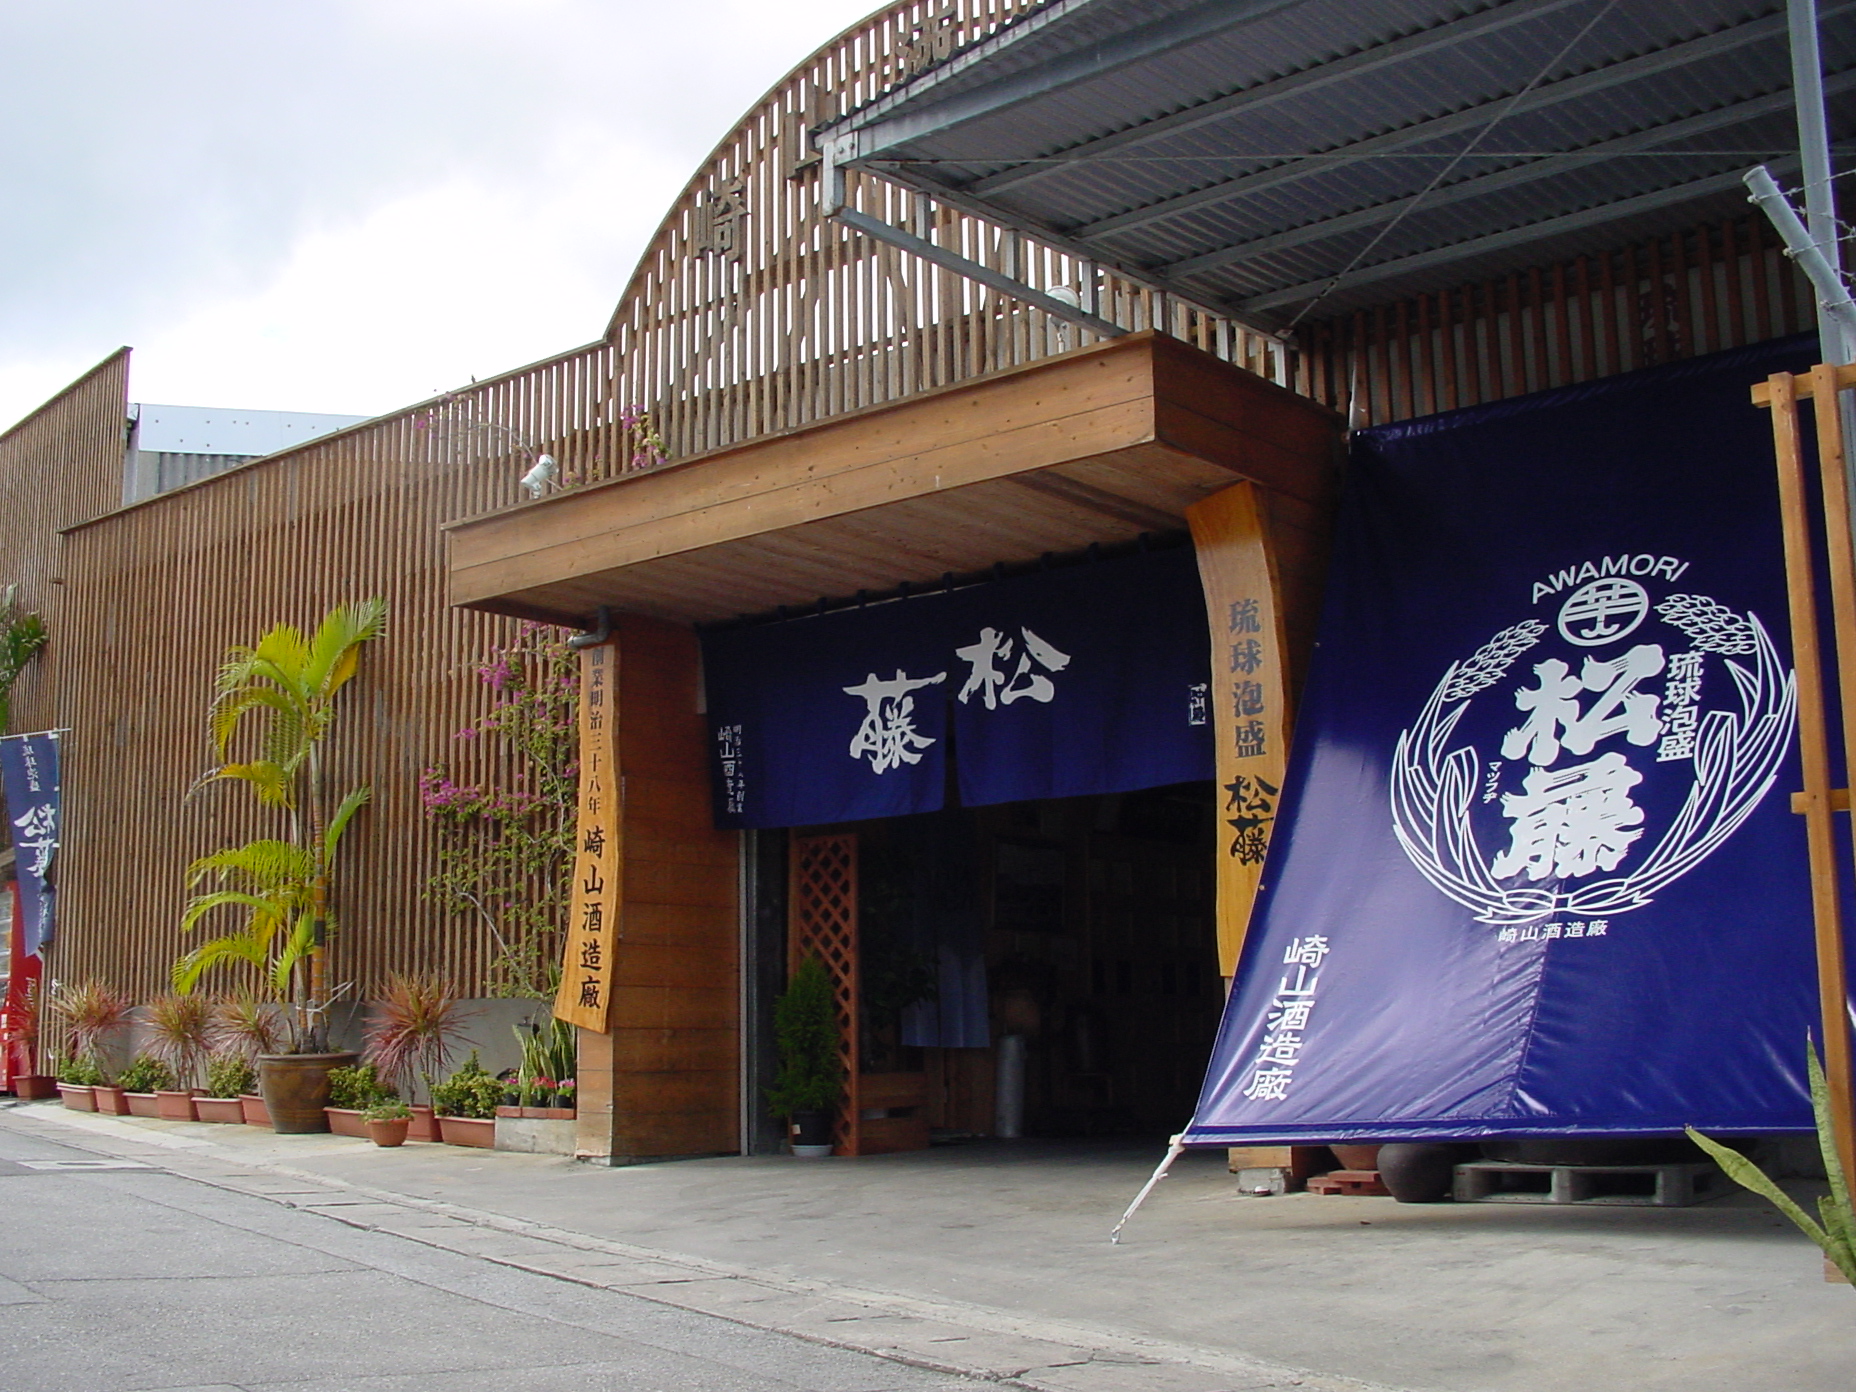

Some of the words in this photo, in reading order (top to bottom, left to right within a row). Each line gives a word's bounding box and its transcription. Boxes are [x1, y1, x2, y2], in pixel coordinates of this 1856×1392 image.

[1532, 553, 1690, 604] AWAMORI
[1228, 598, 1267, 759] 琉球泡盛
[1656, 650, 1704, 763] 琉球泡盛
[1223, 774, 1279, 866] 松藤
[1491, 644, 1666, 881] 松藤
[578, 828, 606, 1010] 崎山酒造廠
[1497, 919, 1609, 943] 崎山酒造廠
[1243, 934, 1330, 1101] 崎山酒造廠
